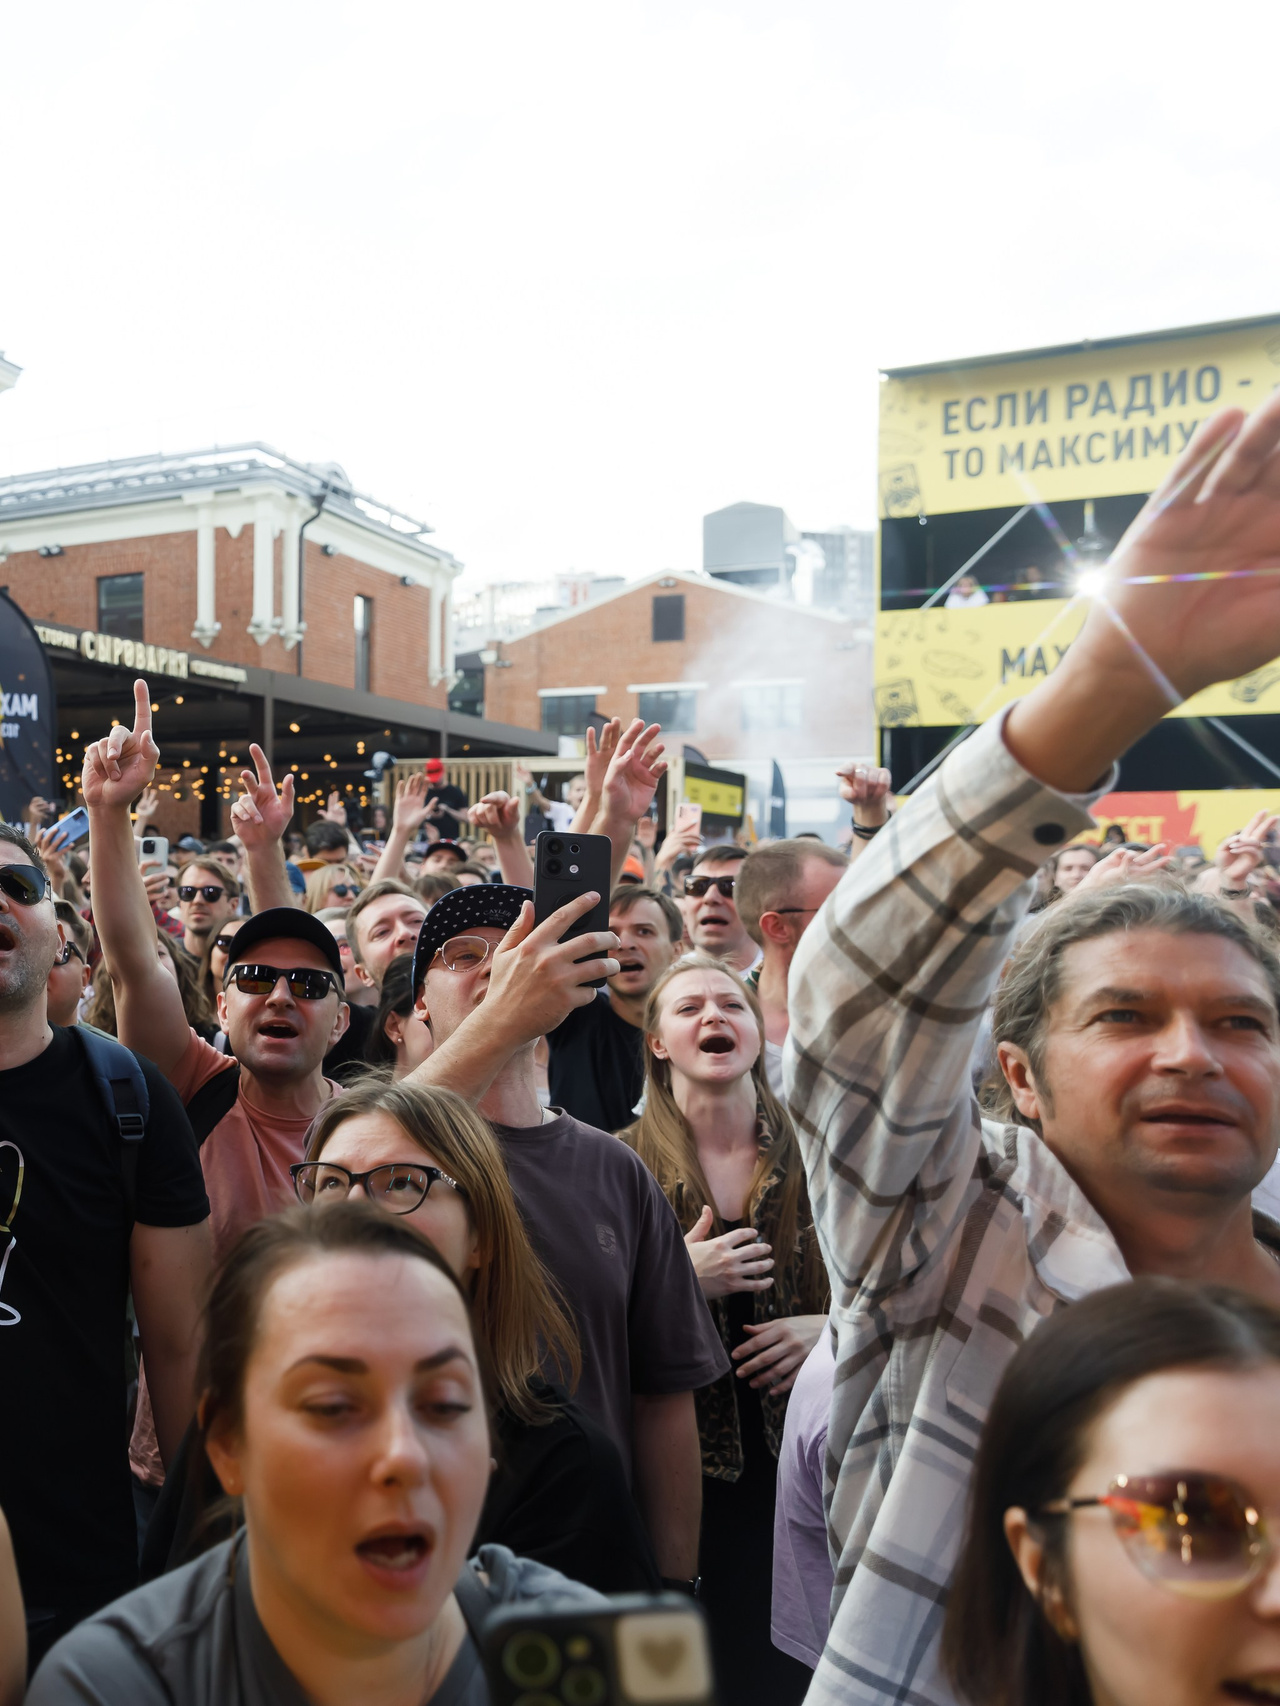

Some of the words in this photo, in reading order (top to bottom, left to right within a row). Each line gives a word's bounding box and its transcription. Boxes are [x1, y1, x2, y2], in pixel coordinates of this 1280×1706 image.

[942, 388, 1049, 436] ЕСЛИ
[1066, 365, 1221, 421] РАДИО
[943, 447, 984, 480] ТО
[998, 419, 1199, 475] МАКСИМУ
